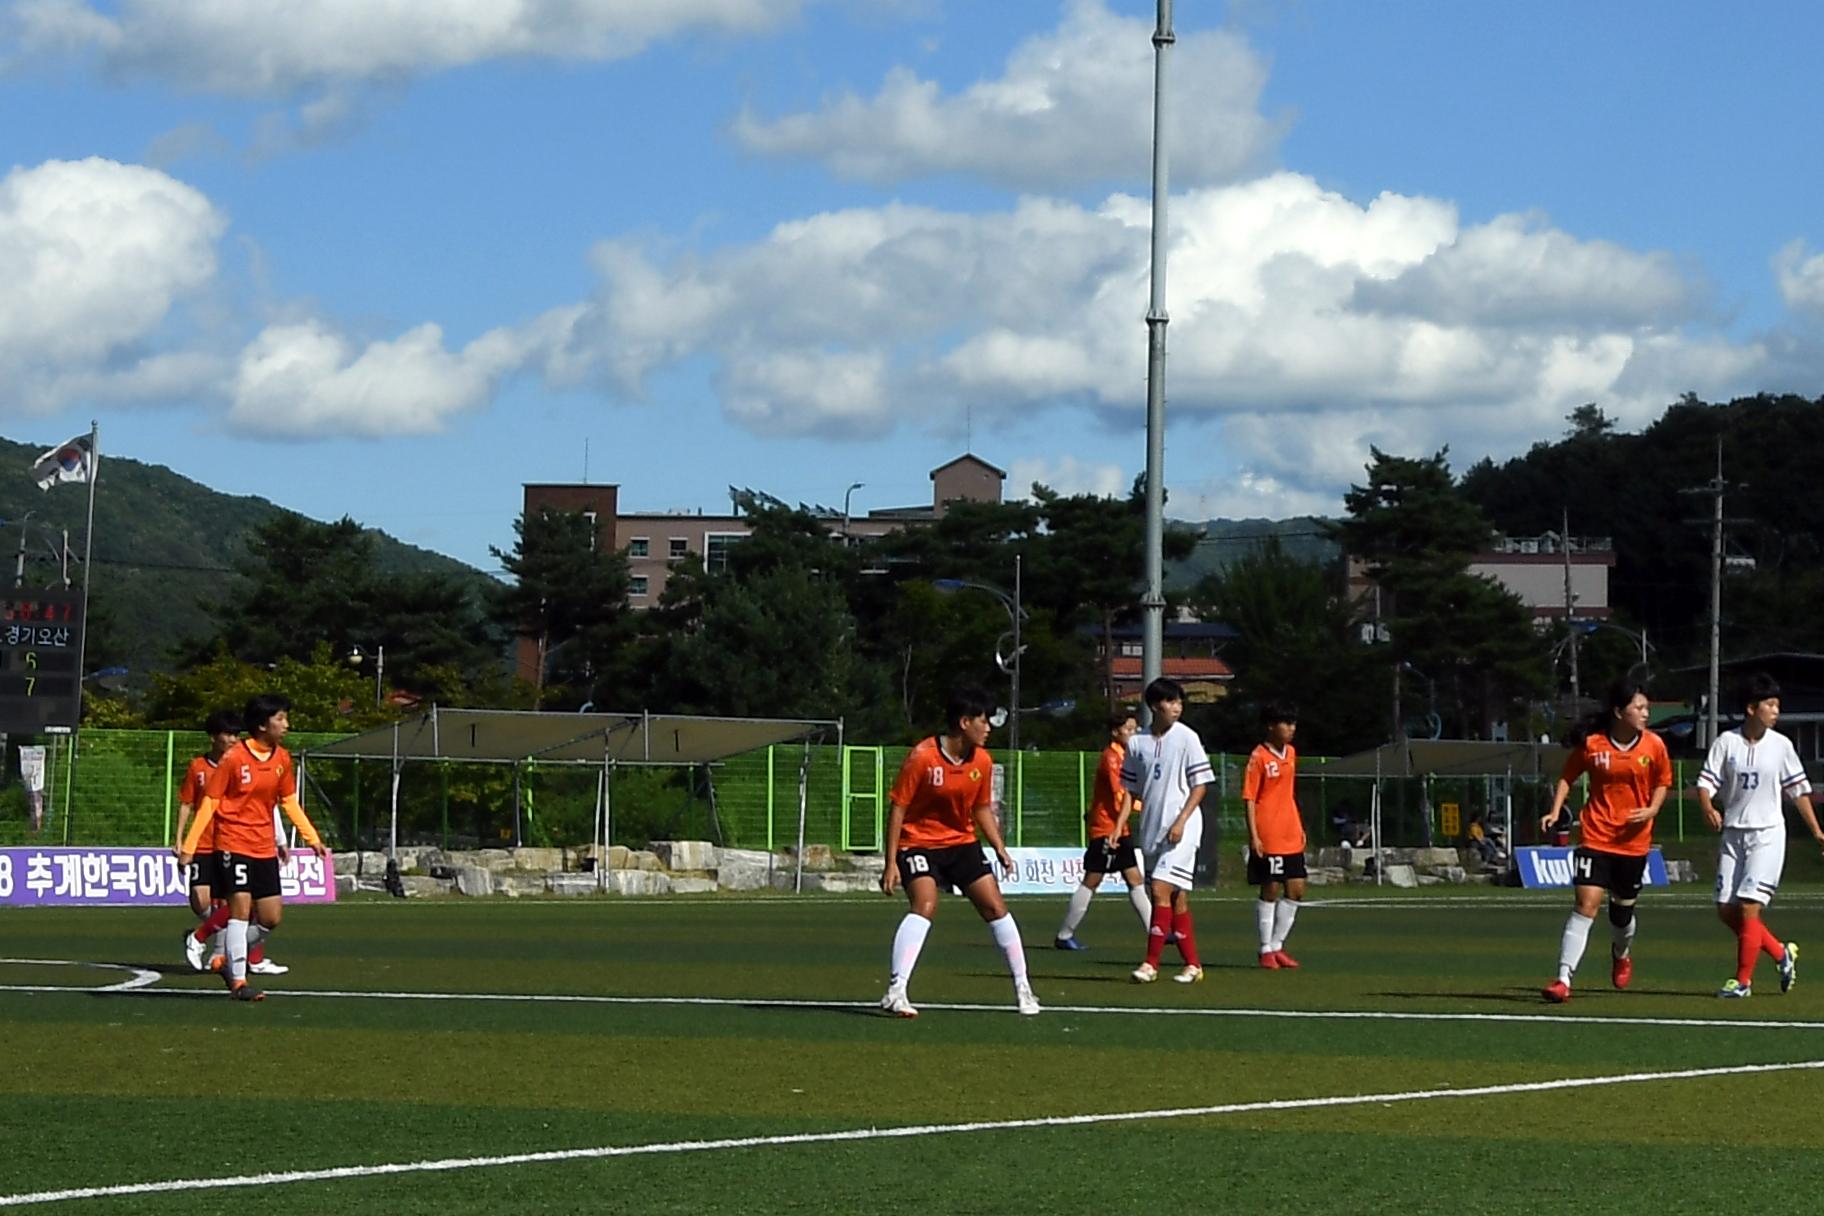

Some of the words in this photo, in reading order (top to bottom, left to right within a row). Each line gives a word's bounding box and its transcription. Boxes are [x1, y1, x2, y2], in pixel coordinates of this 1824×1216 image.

[5, 625, 69, 647] 경기오산
[25, 677, 35, 696] 7
[241, 765, 251, 784] 5
[928, 766, 943, 786] 18
[1265, 760, 1280, 779] 12
[906, 854, 929, 874] 18
[1268, 856, 1284, 875] 12
[235, 863, 247, 885] 5
